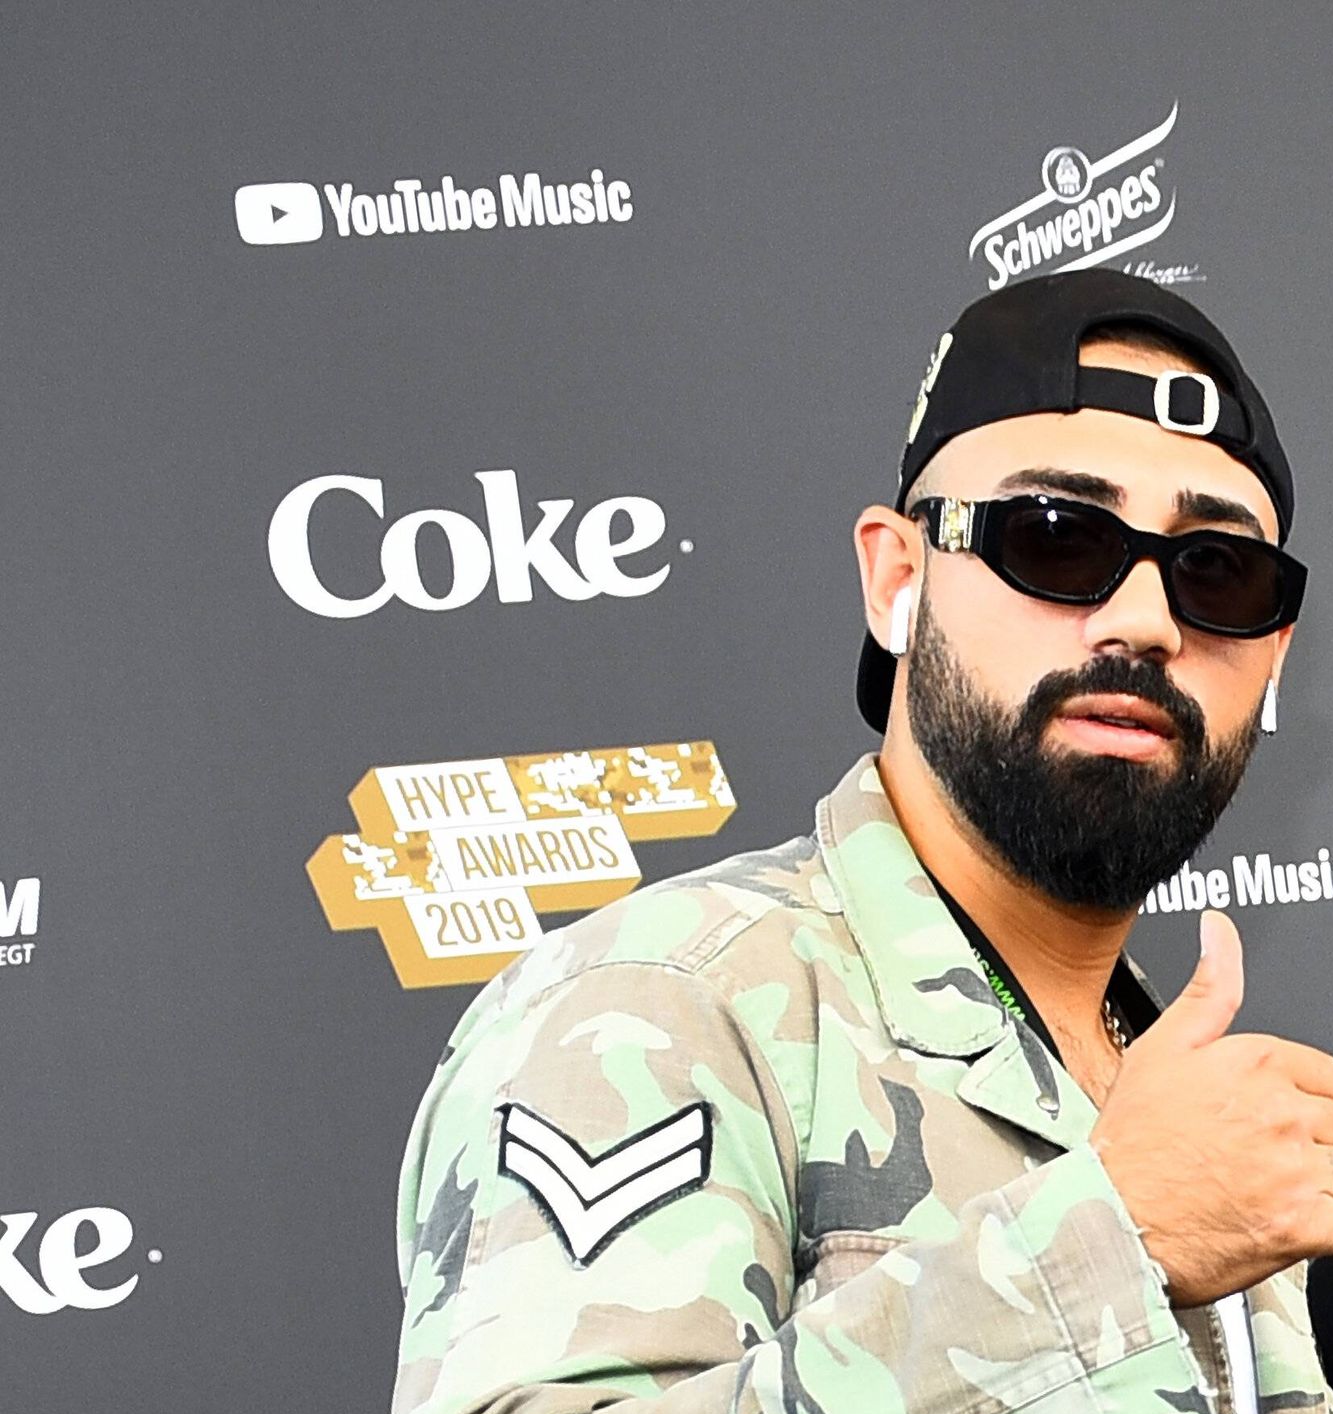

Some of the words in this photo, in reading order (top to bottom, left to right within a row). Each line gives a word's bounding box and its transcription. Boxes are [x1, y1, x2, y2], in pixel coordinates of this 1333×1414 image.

[325, 177, 497, 236] YouTube
[500, 169, 633, 229] Music
[984, 165, 1162, 291] Schweppes
[268, 469, 671, 619] Coke
[397, 771, 507, 820] HYPE
[456, 826, 619, 880] AWARDS
[425, 898, 526, 946] 2019
